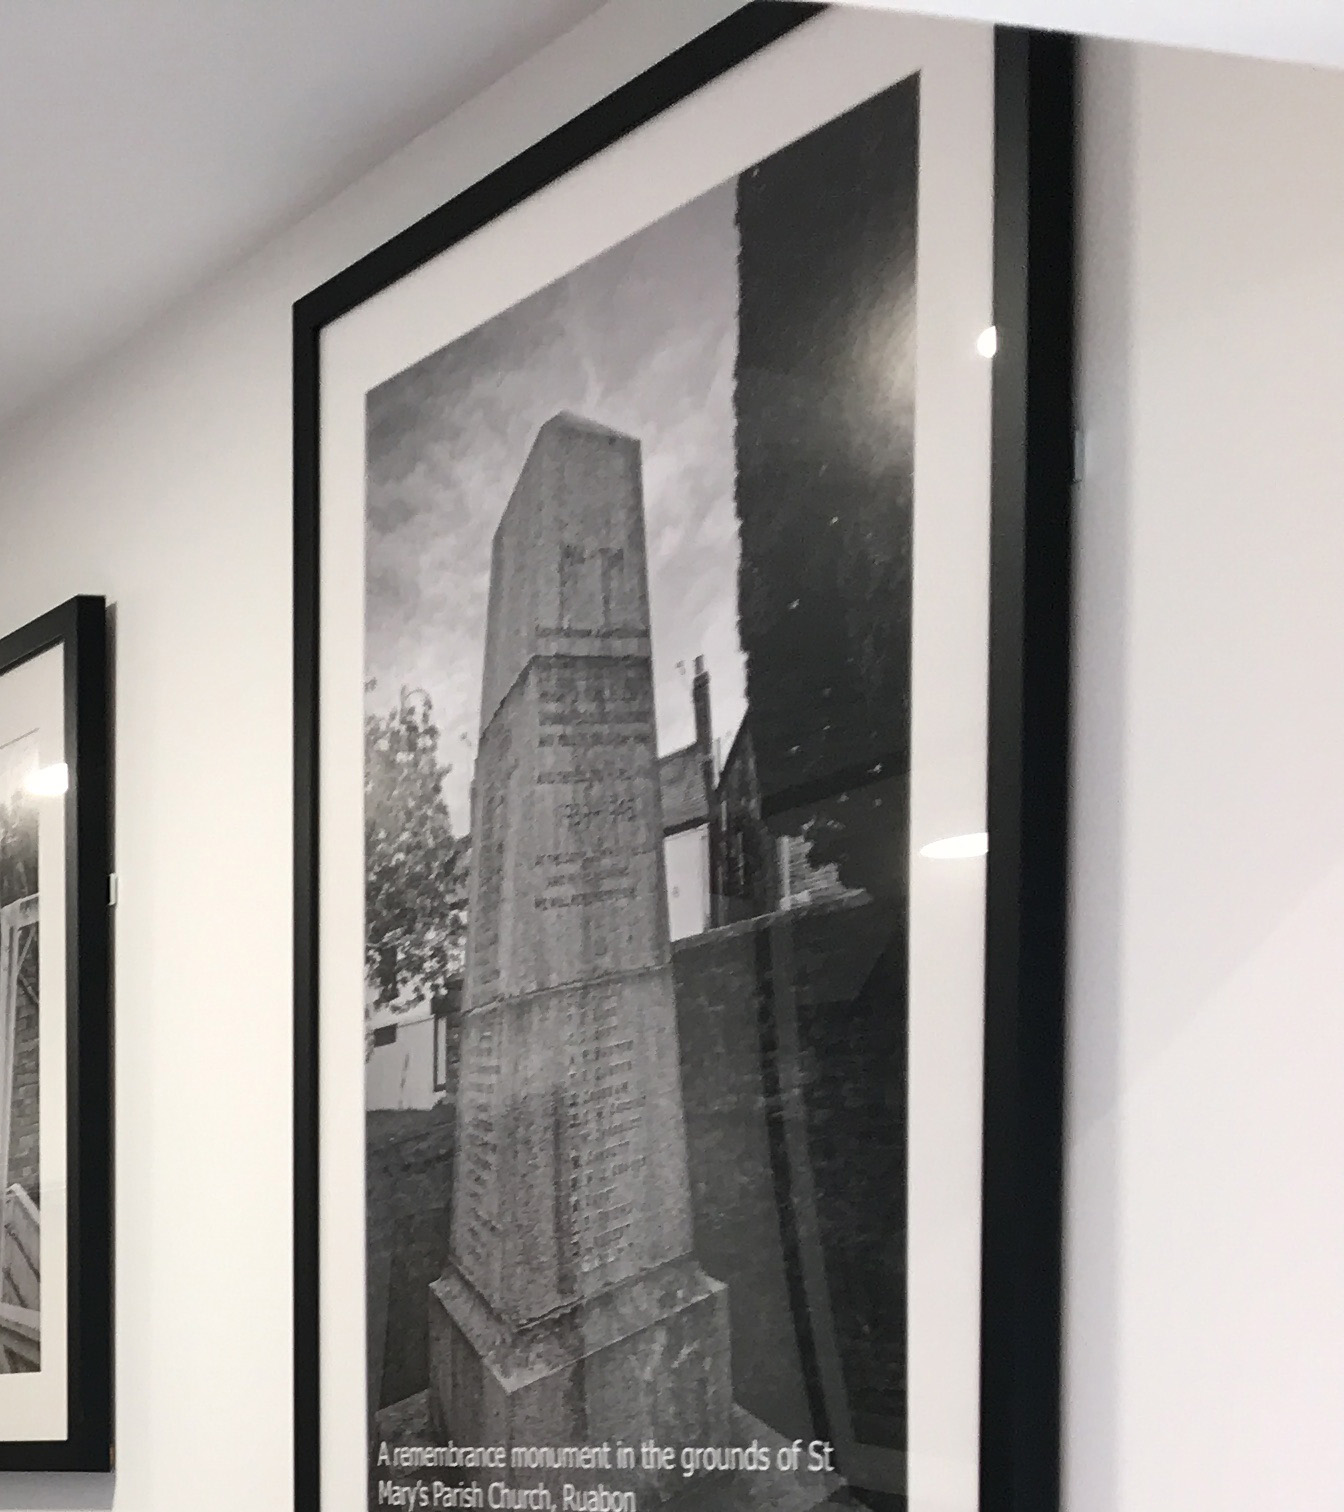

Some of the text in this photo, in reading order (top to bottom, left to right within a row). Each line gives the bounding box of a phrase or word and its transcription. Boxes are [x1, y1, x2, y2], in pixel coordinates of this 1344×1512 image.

[377, 1439, 835, 1477] A remembrance monument in the grounds of St
[378, 1479, 429, 1512] Mary's
[433, 1480, 484, 1508] Parish
[563, 1483, 637, 1512] Ruabon
